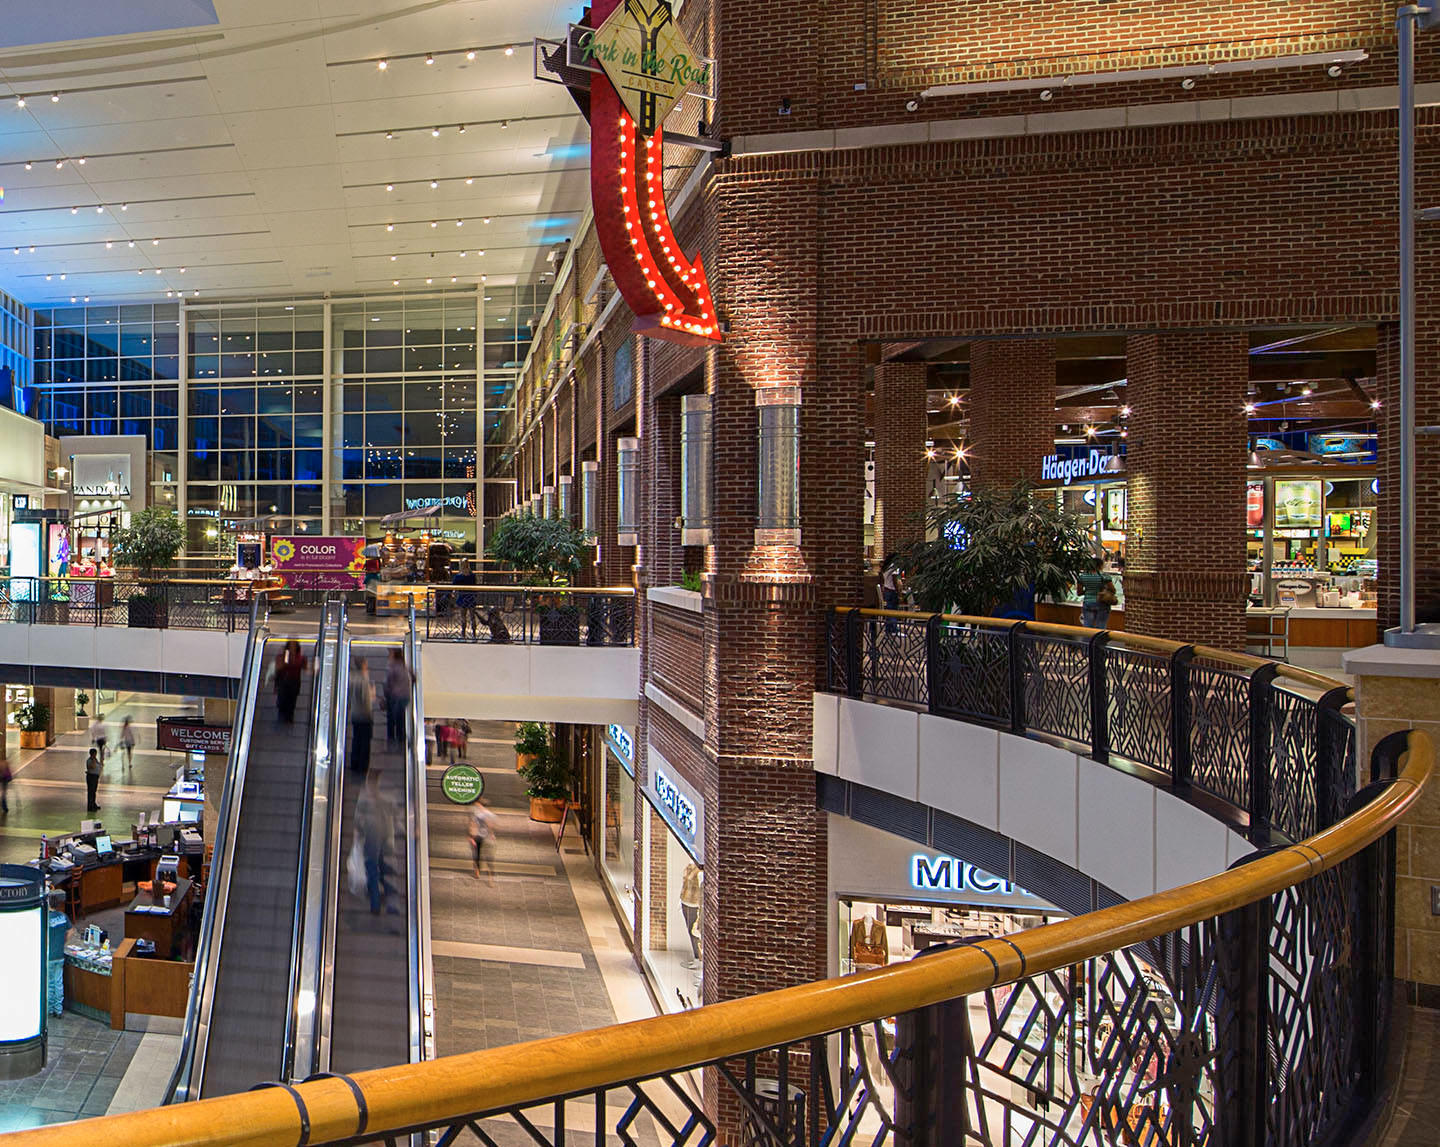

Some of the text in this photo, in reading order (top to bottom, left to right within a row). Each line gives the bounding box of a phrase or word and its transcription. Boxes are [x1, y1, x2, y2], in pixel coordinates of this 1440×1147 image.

[578, 32, 711, 86] Fork in the Road
[1042, 449, 1119, 486] Häagen-Da
[73, 485, 130, 495] PANDA
[300, 545, 336, 555] COLOR
[171, 727, 231, 740] WELCOME
[914, 855, 1032, 894] MIC
